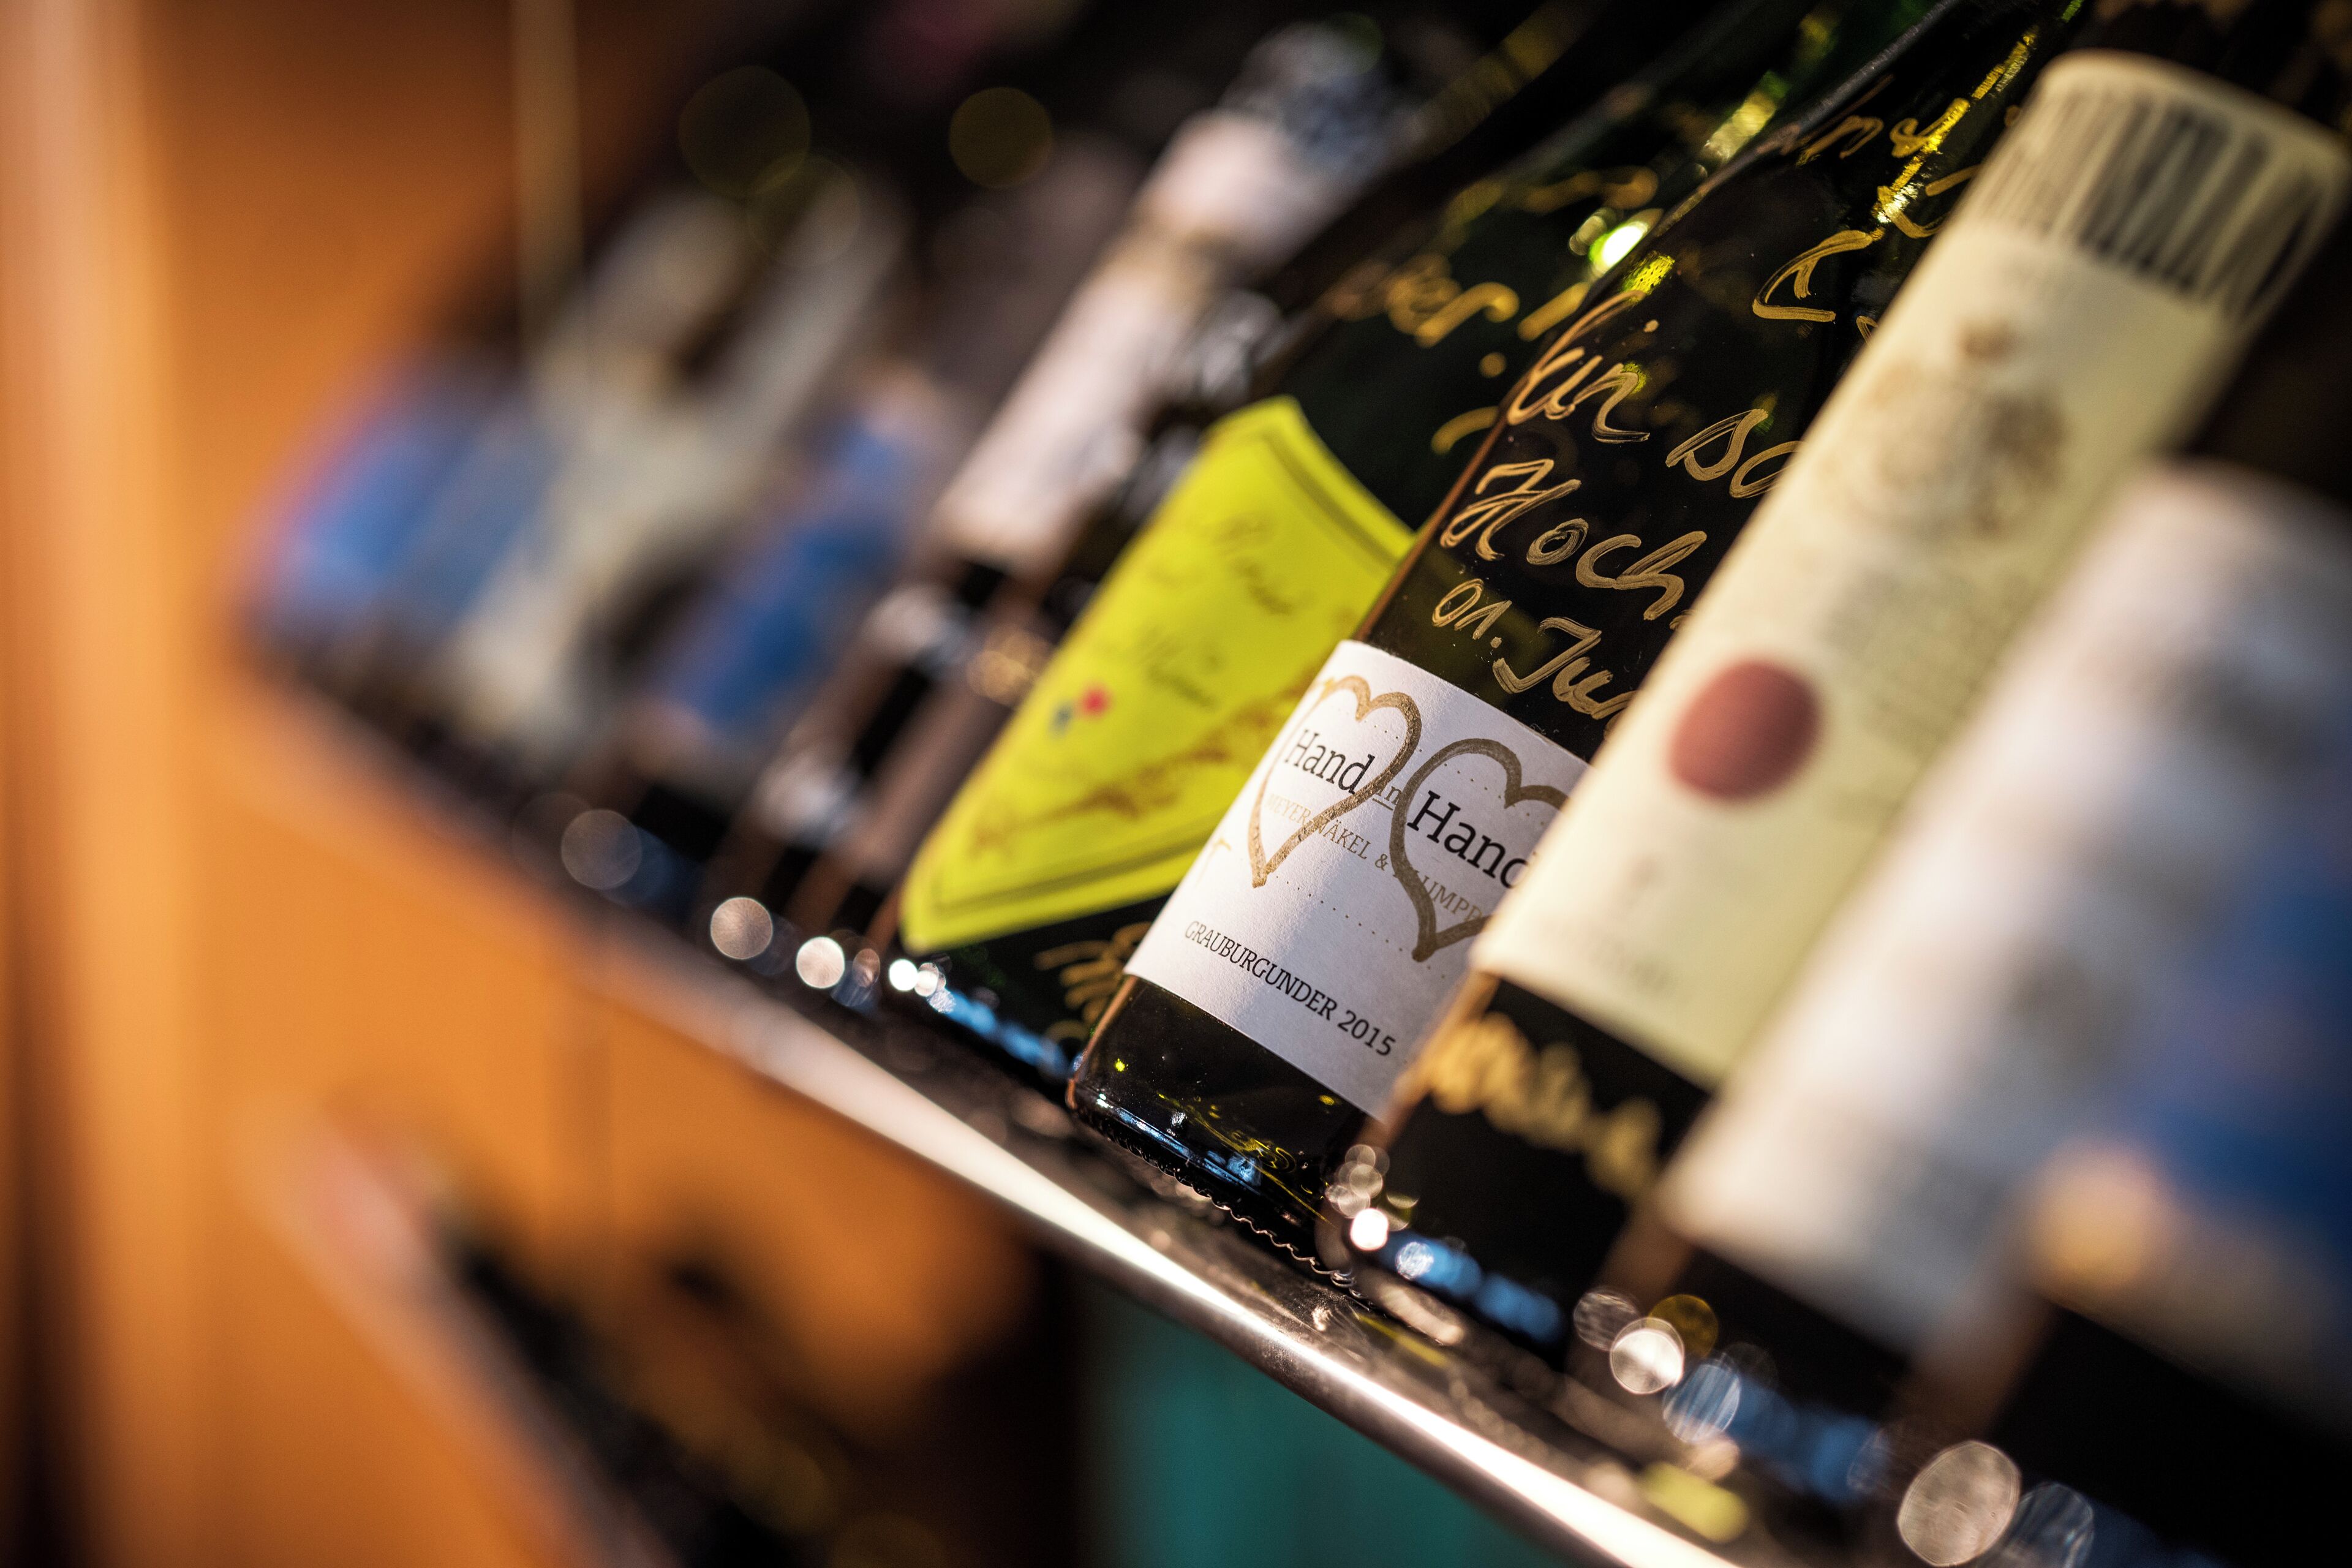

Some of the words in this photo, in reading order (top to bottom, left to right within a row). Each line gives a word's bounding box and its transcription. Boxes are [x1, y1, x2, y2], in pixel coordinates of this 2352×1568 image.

[1440, 459, 1709, 620] Hoch
[1284, 729, 1375, 795] Hand
[1374, 853, 1389, 871] &
[1185, 921, 1338, 1021] GRAUBURGUNDER
[1337, 1009, 1396, 1057] 2015
